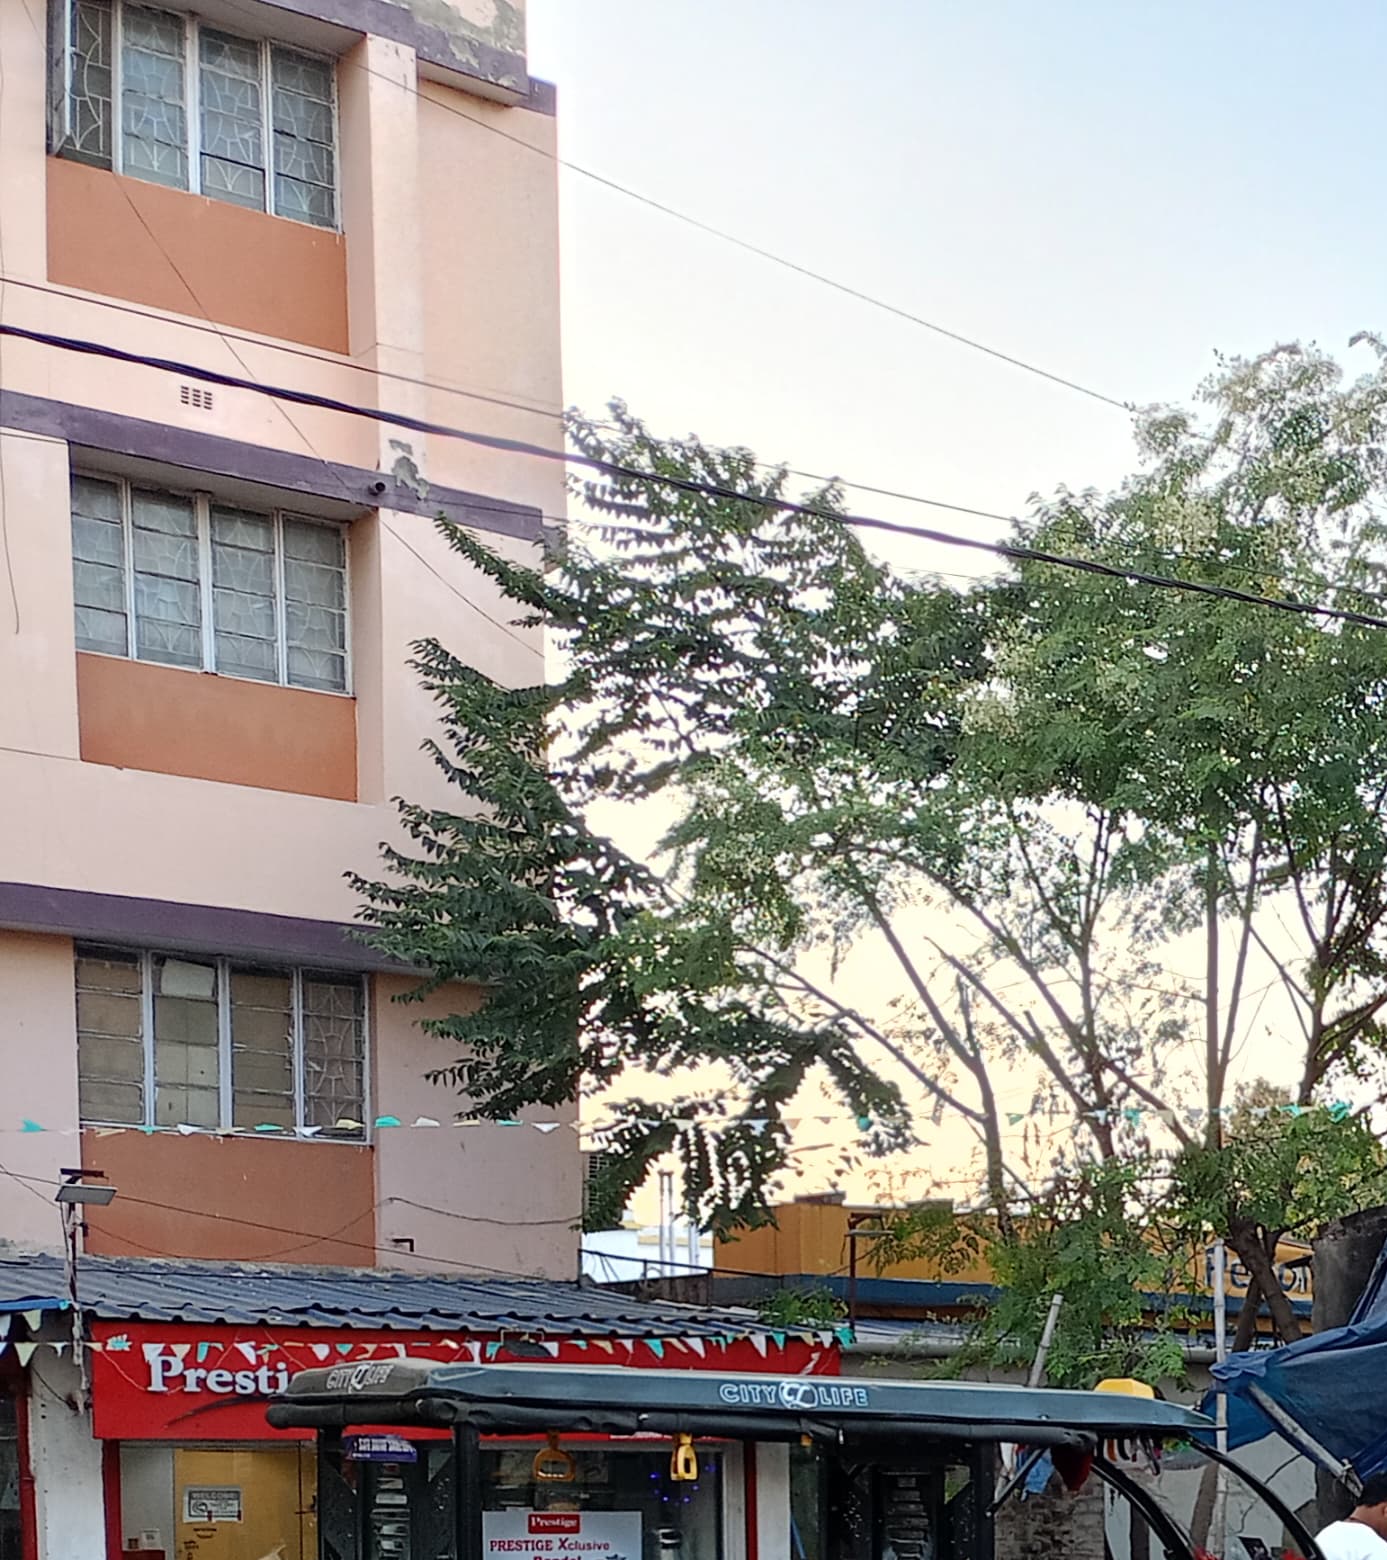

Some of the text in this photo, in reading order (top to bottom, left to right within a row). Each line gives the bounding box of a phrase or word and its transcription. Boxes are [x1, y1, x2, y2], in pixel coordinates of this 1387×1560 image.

[147, 1354, 302, 1394] Presti
[719, 1383, 778, 1404] CITY
[819, 1386, 869, 1407] LIFE
[531, 1515, 578, 1529] Prestige
[489, 1537, 610, 1552] PRESTIGE Xclusive
